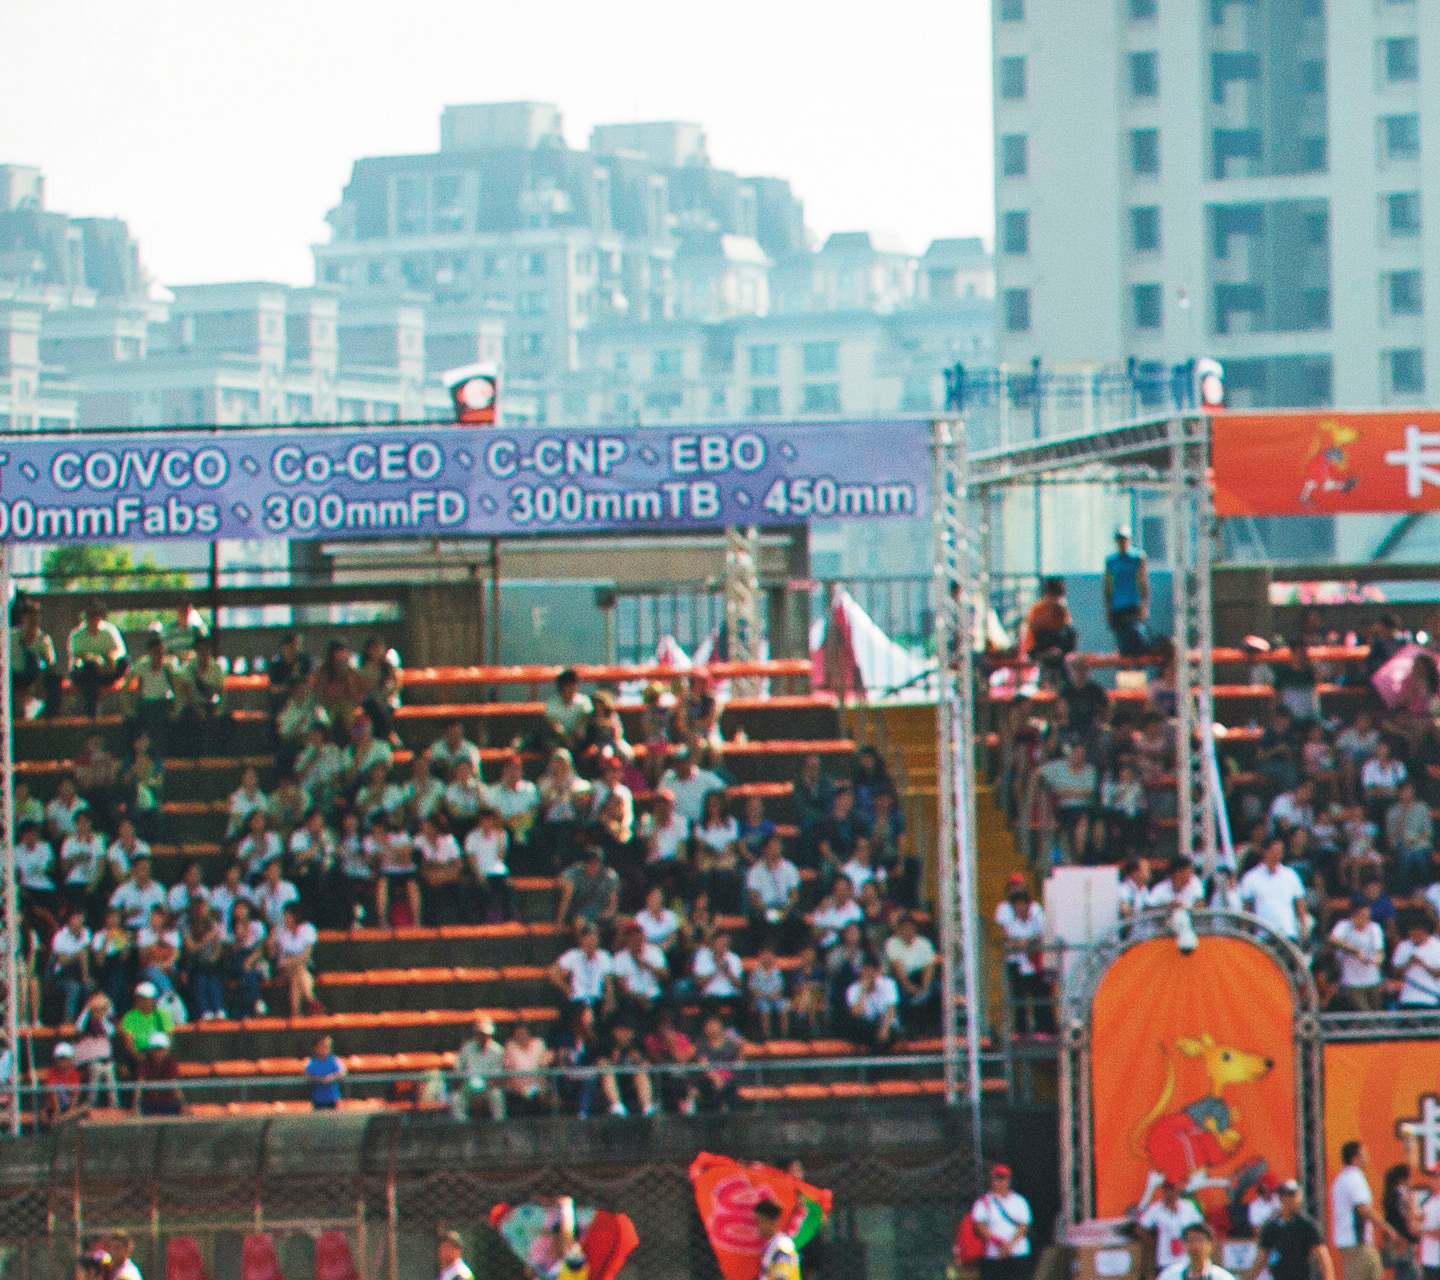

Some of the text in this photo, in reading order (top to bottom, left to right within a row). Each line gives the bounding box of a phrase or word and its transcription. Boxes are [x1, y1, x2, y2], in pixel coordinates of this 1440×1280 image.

[51, 447, 230, 490] CO/VCO
[272, 441, 443, 486] Co-CEO
[487, 436, 628, 477] C-CNP
[670, 435, 767, 473] EBO
[265, 489, 468, 530] 300mmFD
[509, 482, 722, 524] 300mmTB
[764, 479, 916, 517] 450mm
